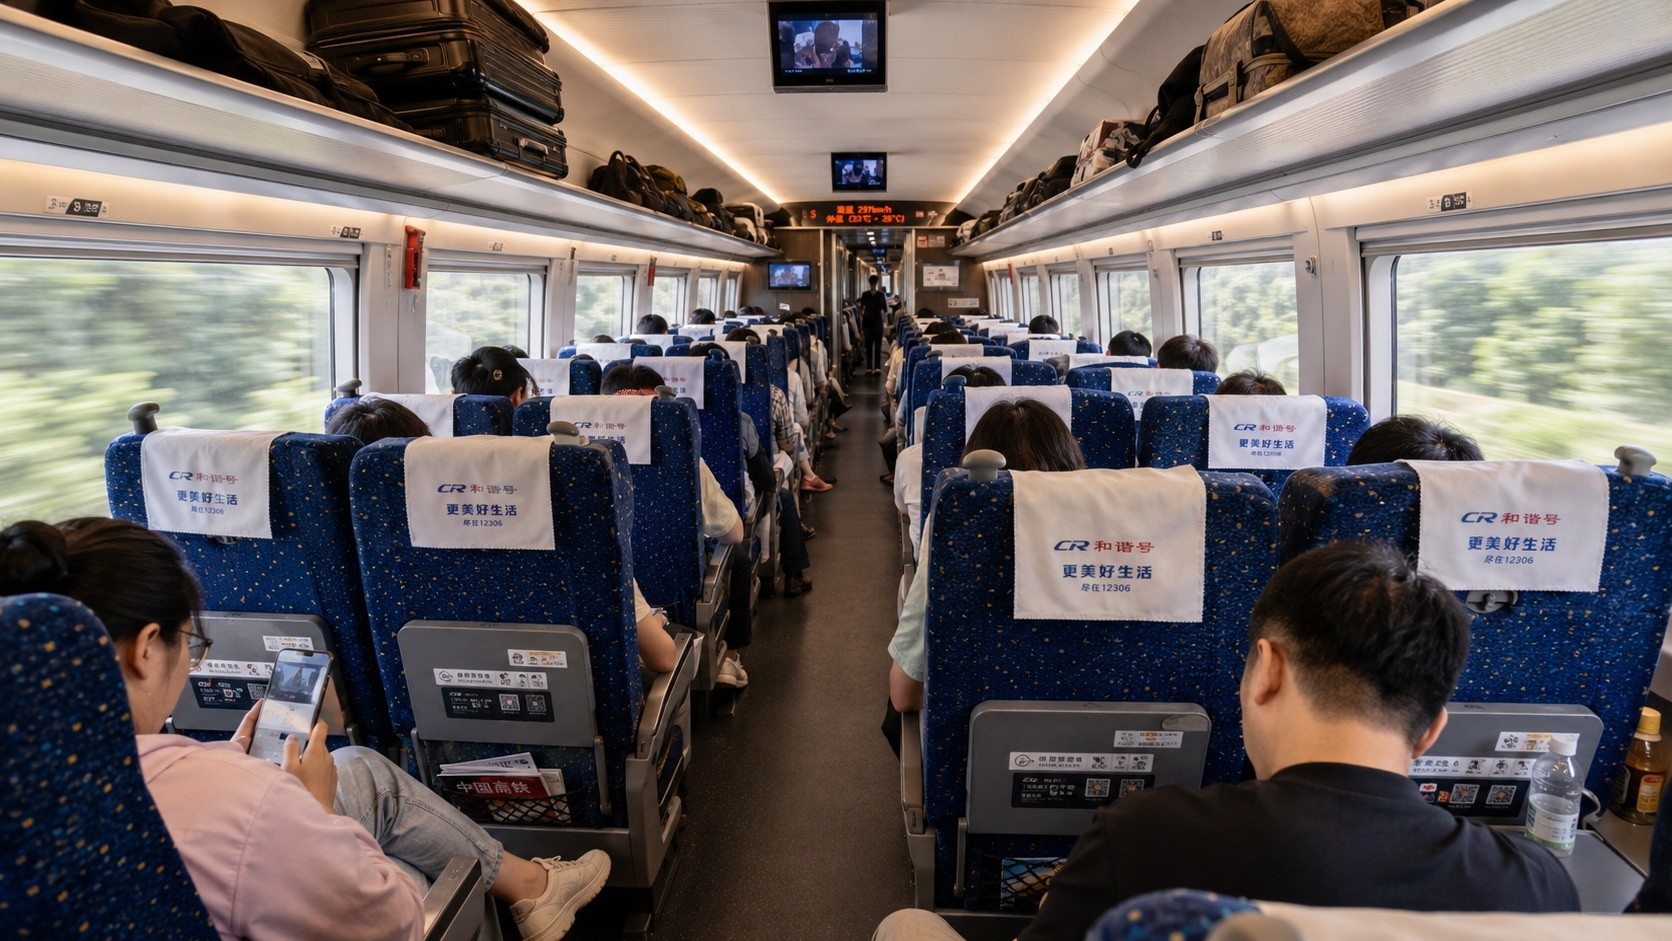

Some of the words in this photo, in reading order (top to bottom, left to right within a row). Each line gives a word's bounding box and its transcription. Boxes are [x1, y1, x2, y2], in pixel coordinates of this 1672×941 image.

[1233, 423, 1257, 432] CR
[1239, 438, 1294, 450] 更美好生活
[168, 470, 194, 481] CR
[437, 483, 467, 494] CR
[177, 489, 238, 506] 更美好生活
[446, 503, 517, 517] 更美好生活
[1460, 511, 1498, 524] CR
[1500, 512, 1562, 526] 和谐号
[1053, 540, 1090, 551] CR
[1093, 540, 1155, 553] 和谐号
[1467, 535, 1557, 552] 更美好生活
[1062, 563, 1153, 580] 更美好生活
